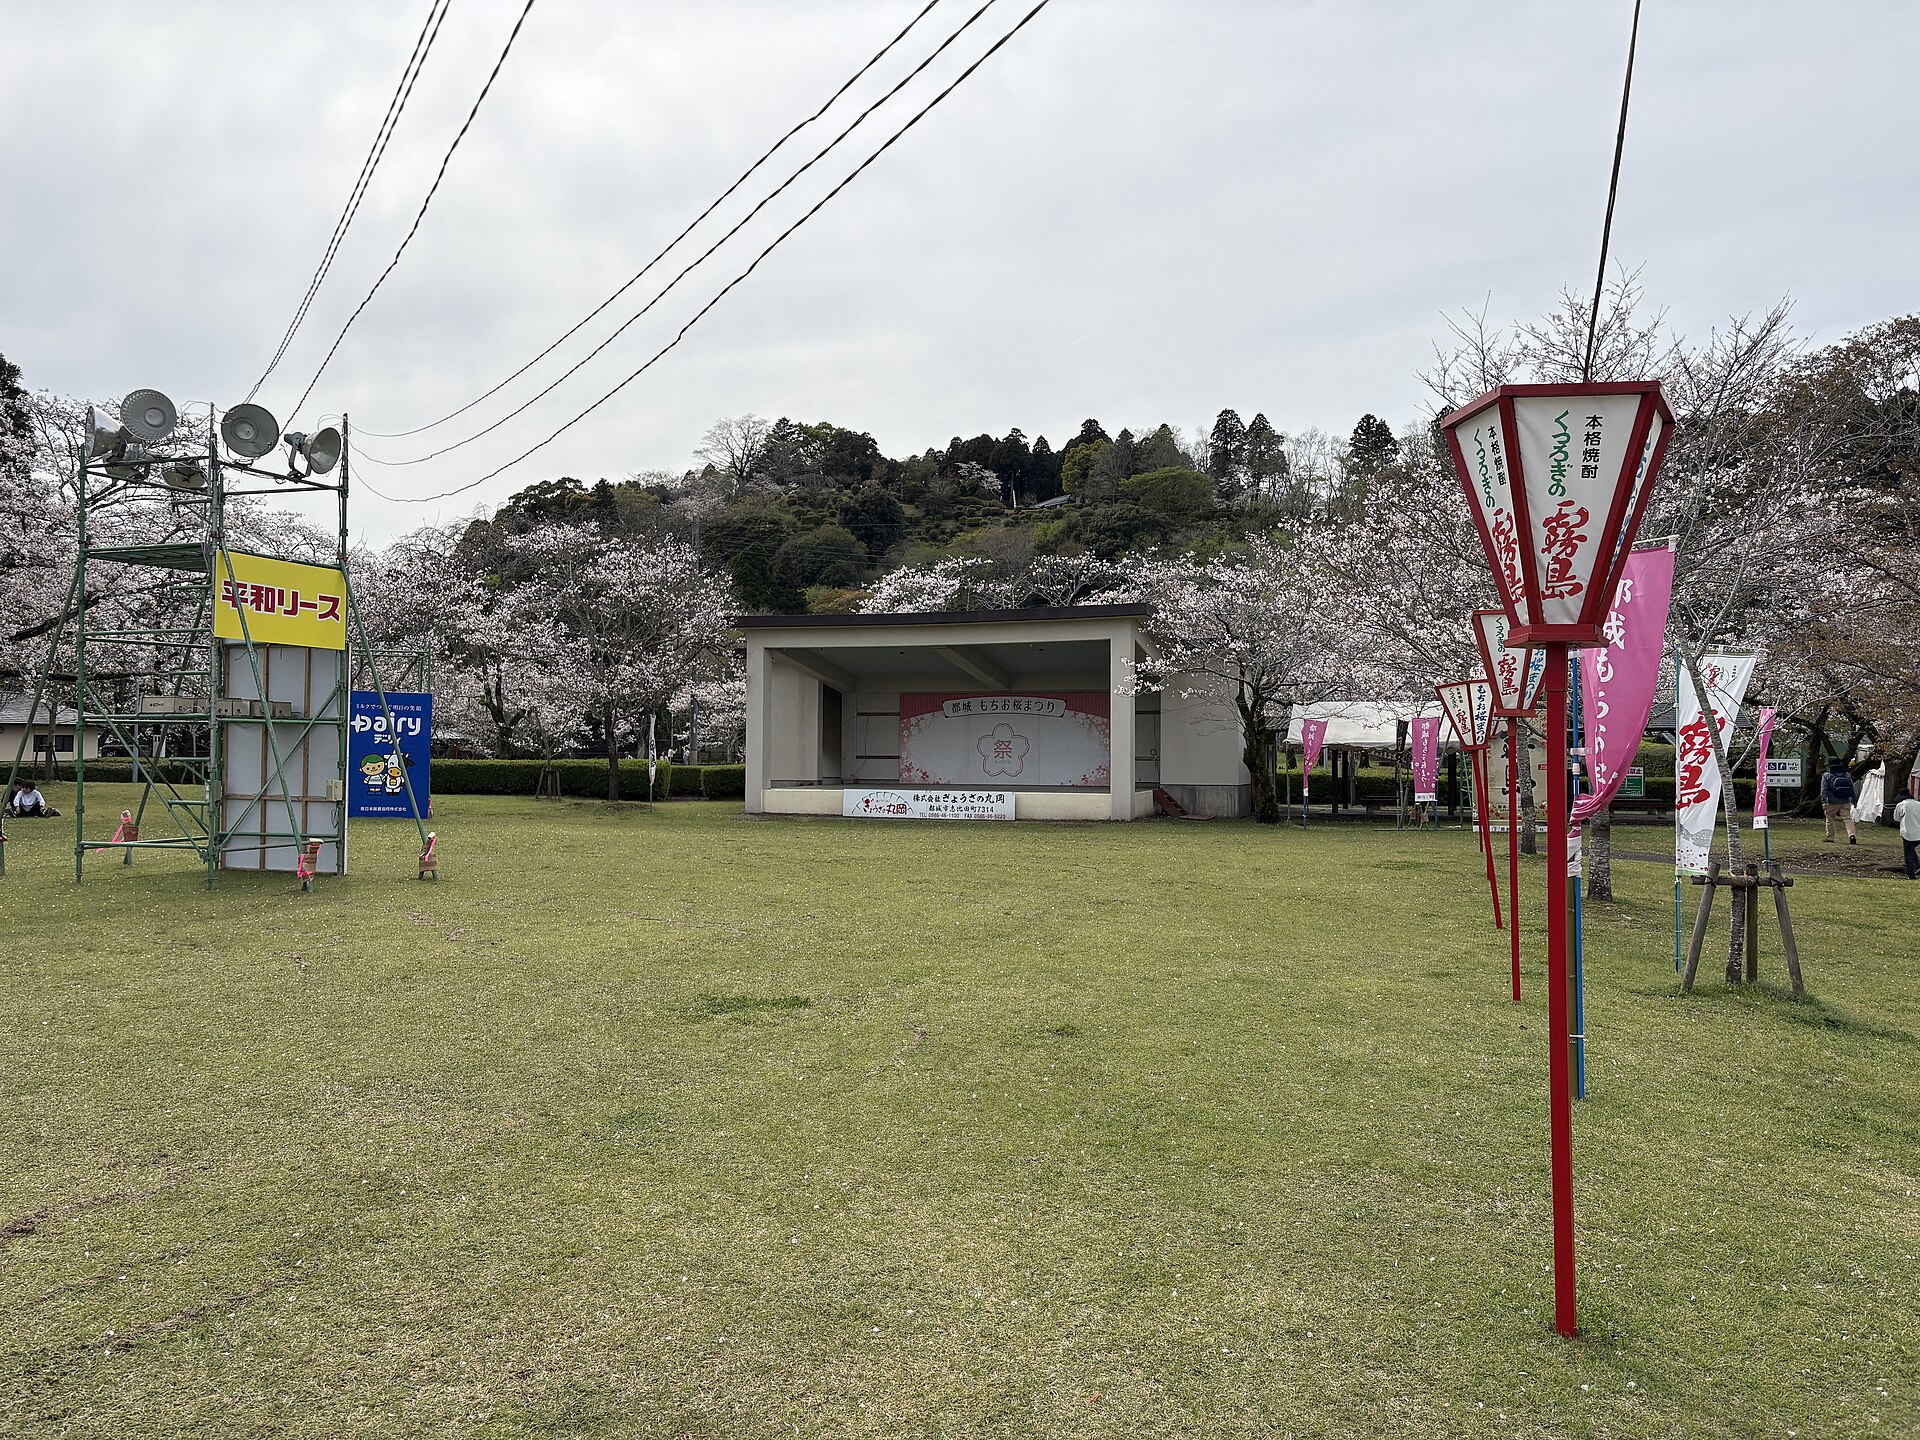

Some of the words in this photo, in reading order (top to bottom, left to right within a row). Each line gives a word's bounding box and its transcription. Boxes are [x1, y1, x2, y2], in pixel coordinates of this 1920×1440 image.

[1474, 428, 1496, 508] くつろぎの
[1487, 425, 1507, 486] 本格焼酎
[1548, 410, 1573, 497] くつろぎの
[1581, 414, 1603, 479] 本格焼酎
[1541, 500, 1590, 600] 霧島
[221, 580, 340, 622] 平和リース
[1498, 653, 1519, 697] 霧島
[356, 703, 422, 712] ミルクでつぐ明日の笑顔
[951, 701, 972, 713] 都城
[979, 699, 1055, 713] もちお桜まつり
[1475, 684, 1488, 743] もちお桜まつり
[993, 739, 1012, 760] 祭
[913, 793, 1005, 804] 株式会社ぎょうざの丸岡
